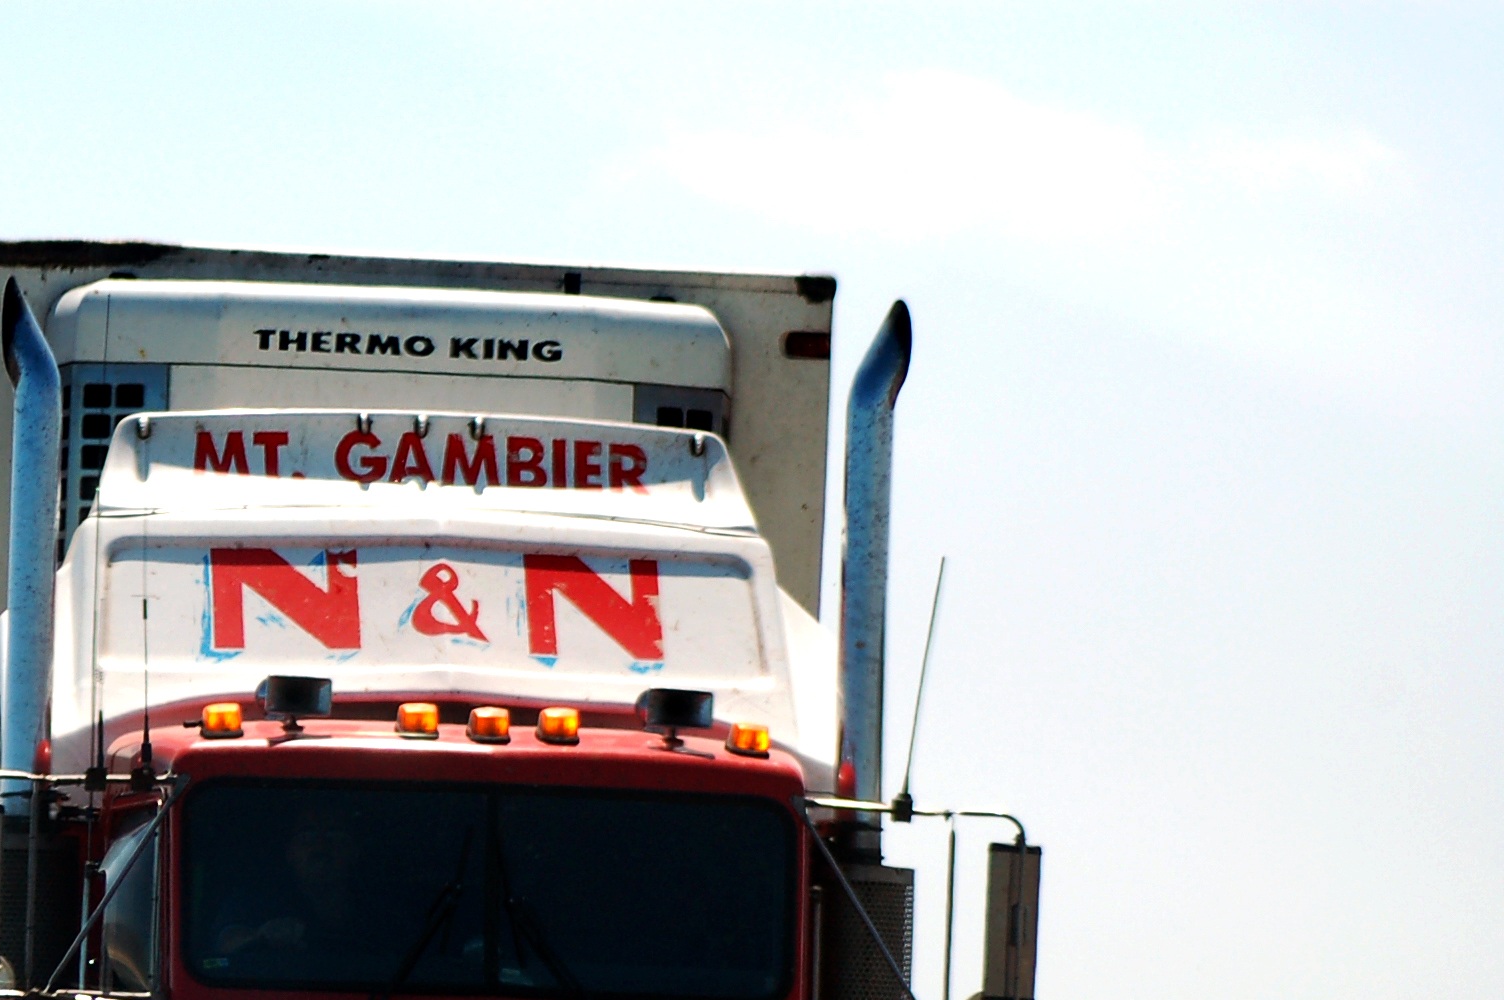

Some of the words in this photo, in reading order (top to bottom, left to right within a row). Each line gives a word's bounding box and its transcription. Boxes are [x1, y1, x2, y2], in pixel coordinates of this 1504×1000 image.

[253, 329, 436, 358] THERMO
[450, 337, 563, 363] KING
[194, 431, 305, 481] MT.
[334, 430, 649, 494] GAMBIER
[209, 548, 362, 650] N
[410, 562, 490, 643] &
[521, 553, 665, 661] N
